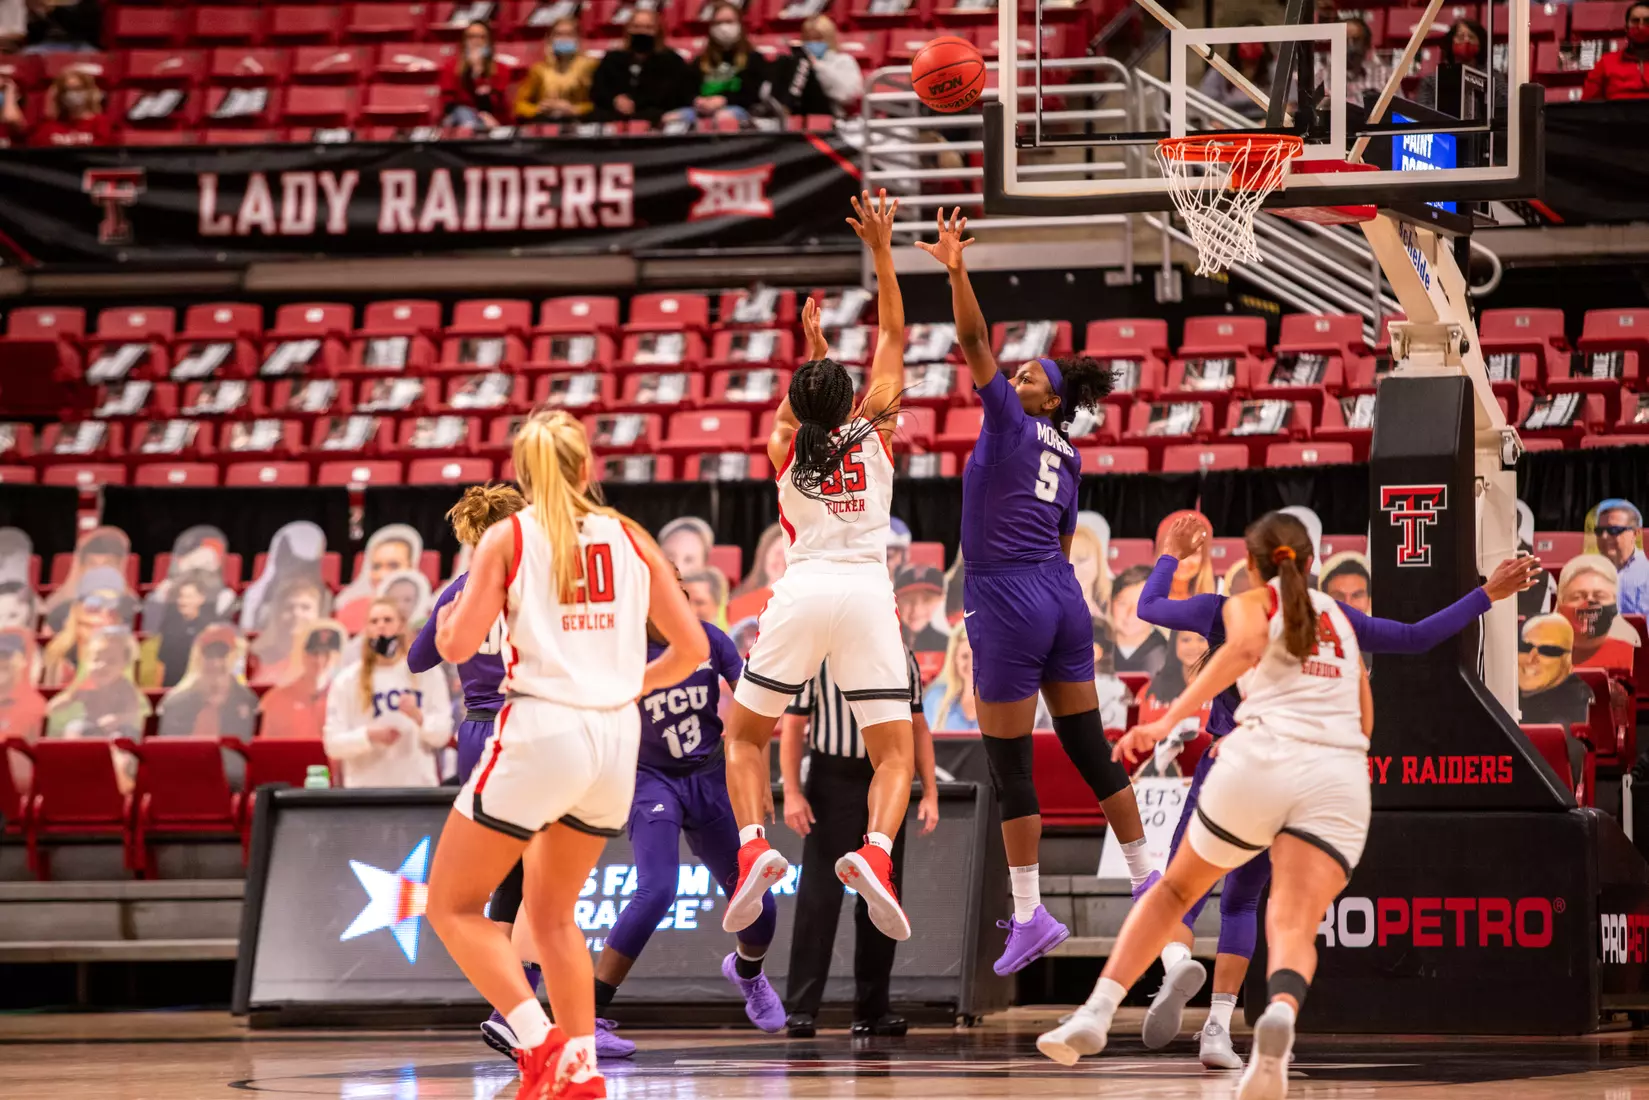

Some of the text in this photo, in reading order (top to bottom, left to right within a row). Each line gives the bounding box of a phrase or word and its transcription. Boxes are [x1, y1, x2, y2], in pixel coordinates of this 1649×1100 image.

[928, 75, 963, 96] NCAA
[1403, 133, 1434, 159] PAINT
[198, 163, 634, 236] LADY RAIDERS
[1398, 219, 1431, 291] Schelde
[1034, 449, 1062, 503] 5
[825, 498, 867, 516] TUCKER
[643, 685, 709, 725] TCU
[661, 714, 702, 760] 13
[1401, 755, 1514, 785] RAIDERS
[602, 863, 711, 897] FAM
